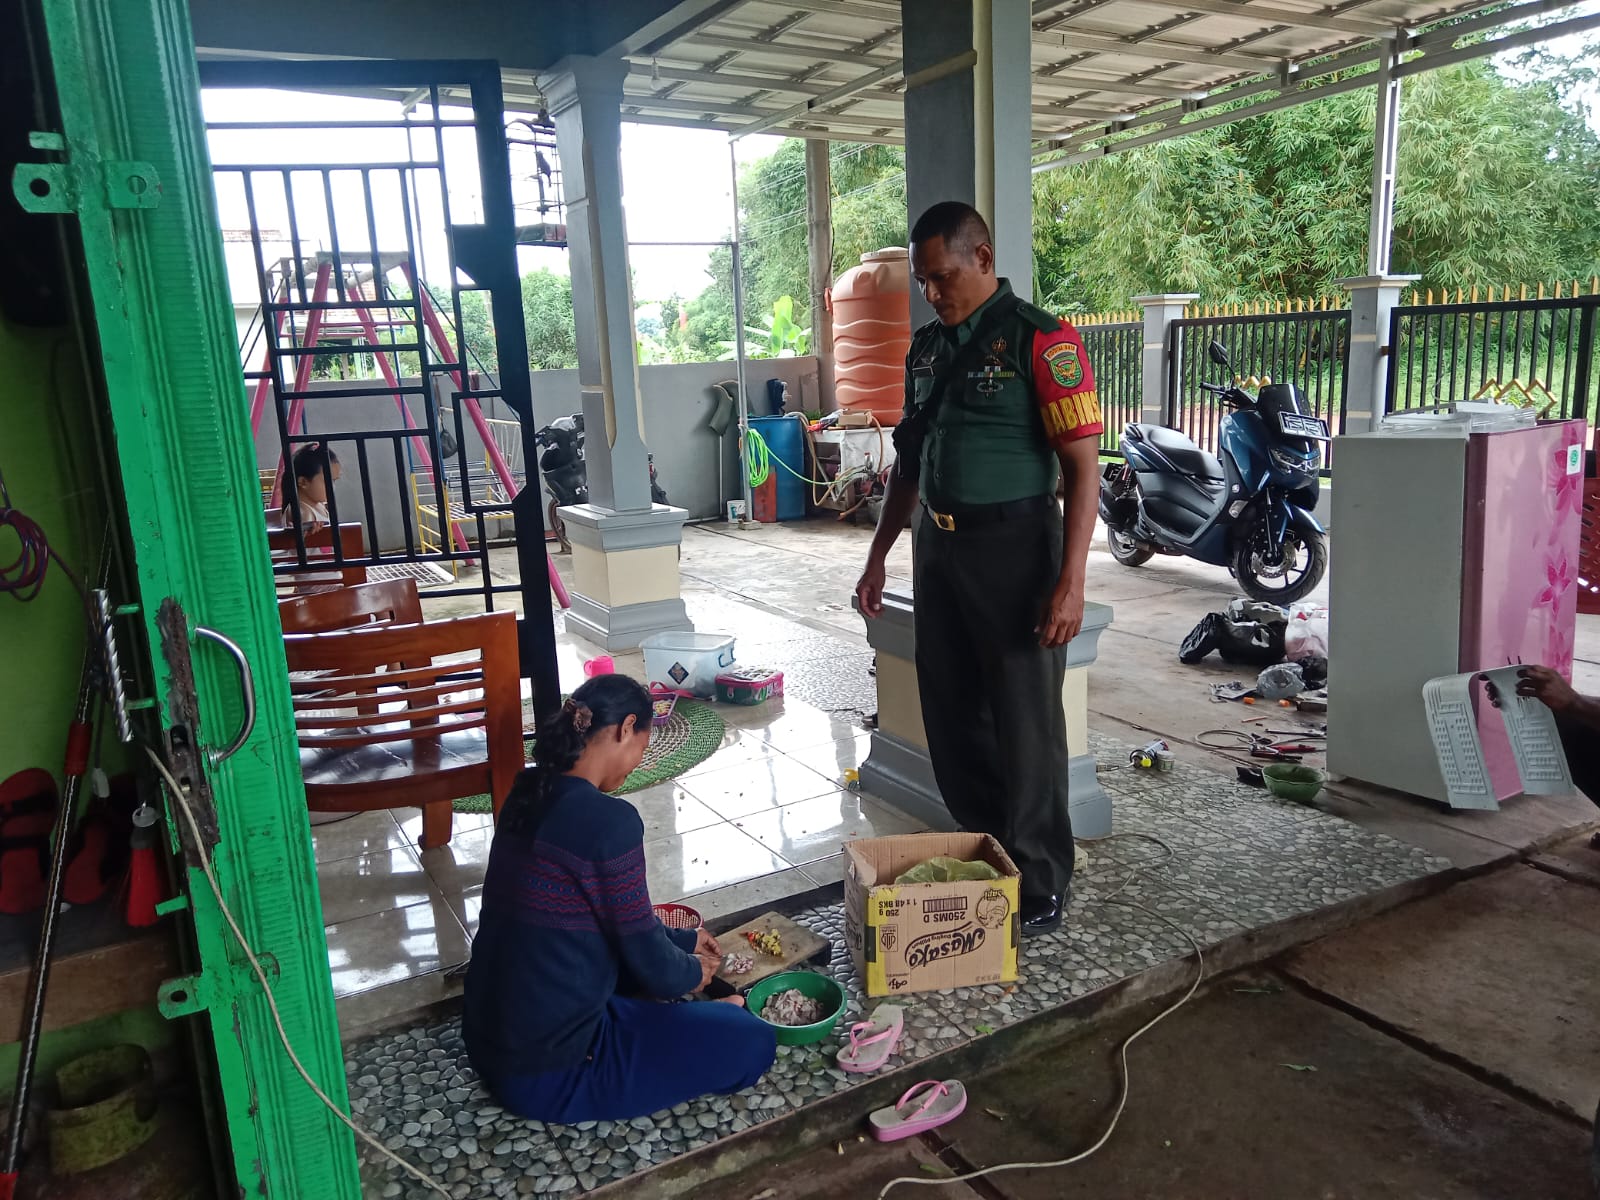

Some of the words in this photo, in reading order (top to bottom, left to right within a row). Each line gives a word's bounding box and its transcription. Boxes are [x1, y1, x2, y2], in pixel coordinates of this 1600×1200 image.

[879, 900, 893, 908] BKS
[886, 909, 899, 917] 250
[933, 911, 966, 922] 250MS
[923, 914, 930, 923] D
[908, 927, 986, 968] Masako
